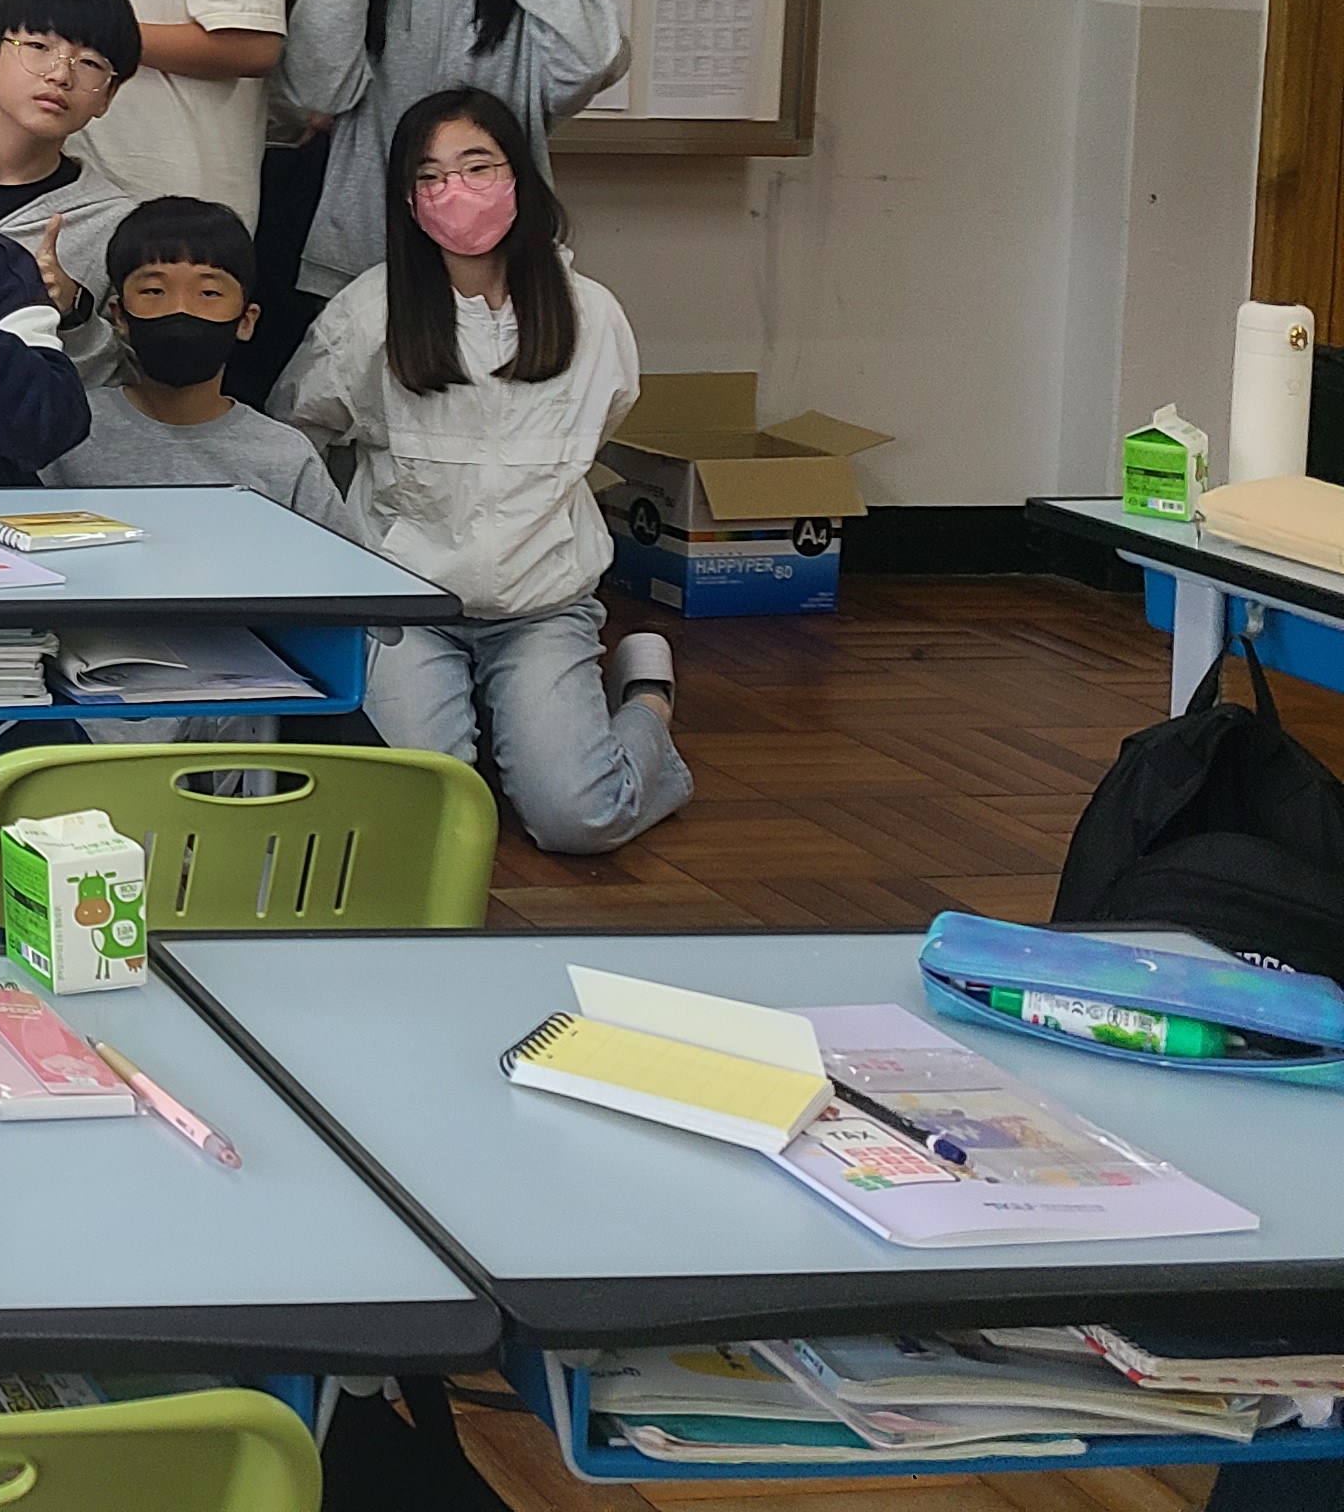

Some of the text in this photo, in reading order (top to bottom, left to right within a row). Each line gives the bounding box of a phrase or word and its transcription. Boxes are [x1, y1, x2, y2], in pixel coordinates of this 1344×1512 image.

[796, 519, 829, 546] A4
[695, 558, 775, 575] HAPPYPER
[827, 1129, 878, 1142] TAX
